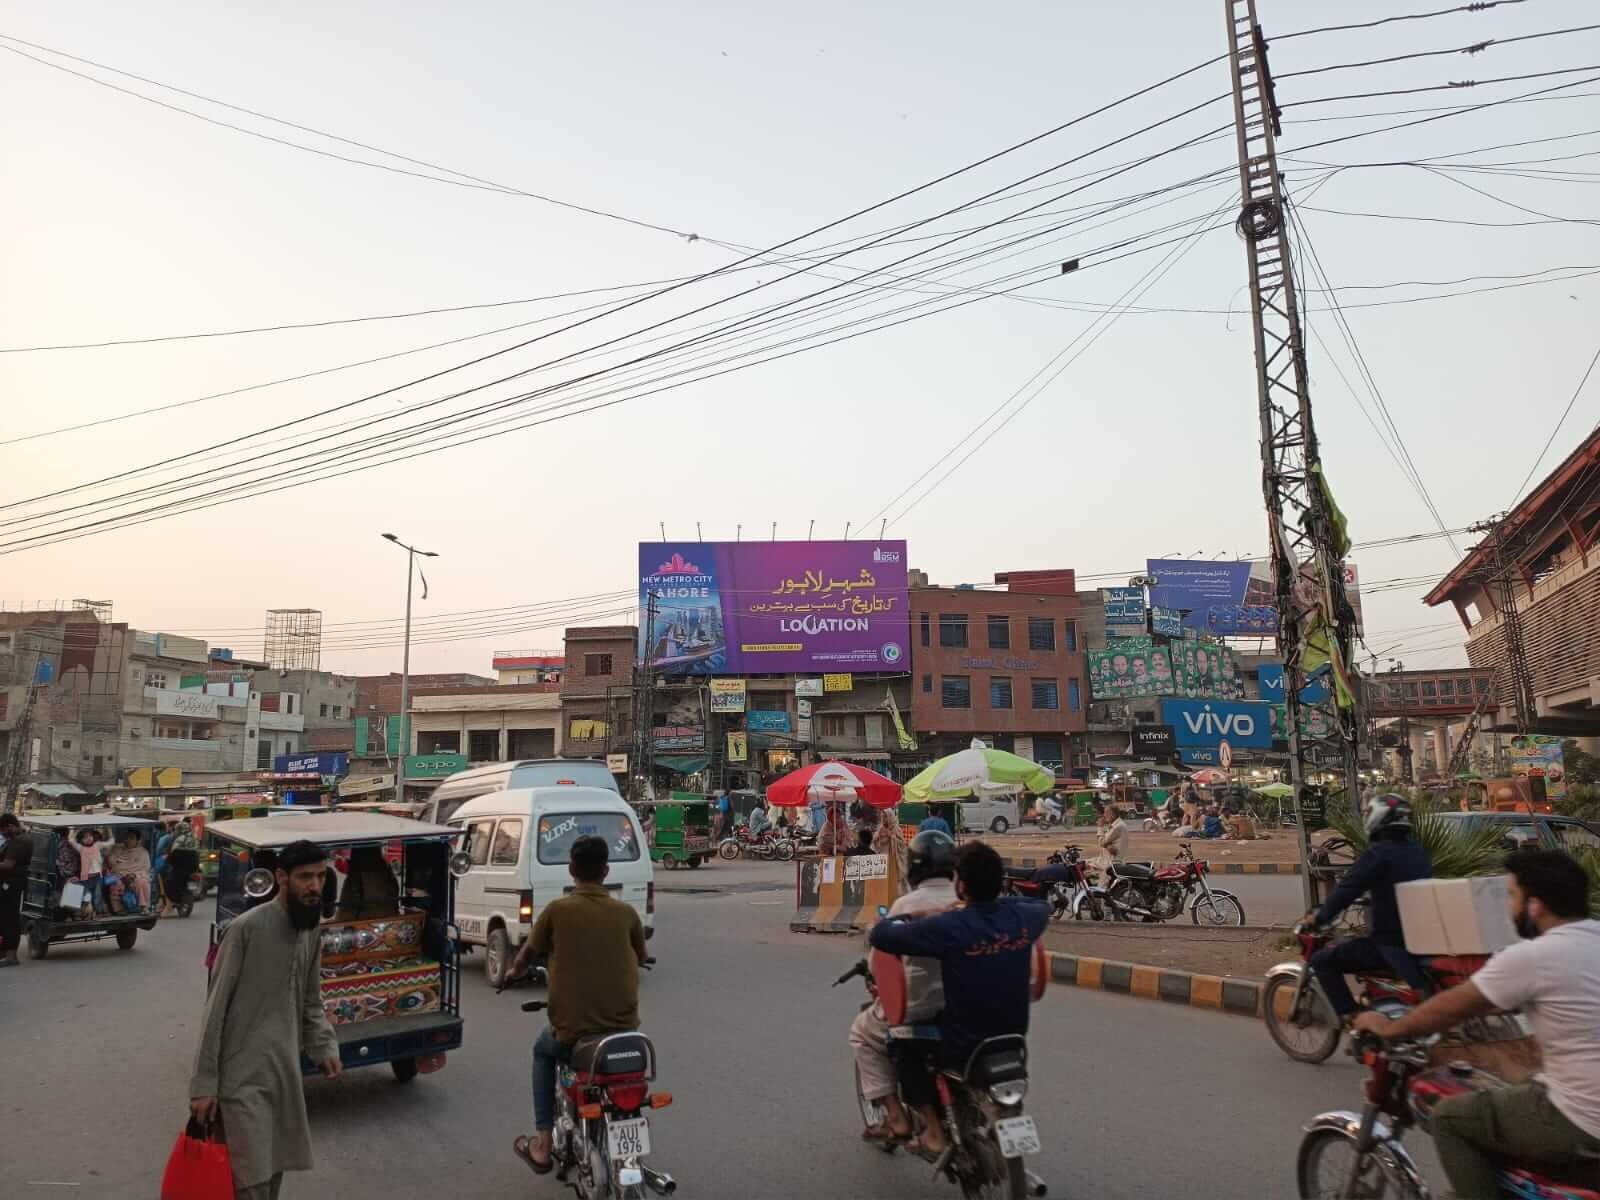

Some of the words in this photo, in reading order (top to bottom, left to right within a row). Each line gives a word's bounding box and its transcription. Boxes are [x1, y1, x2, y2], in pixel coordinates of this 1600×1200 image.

[642, 575, 660, 584] NEW
[662, 575, 692, 583] METRO
[693, 575, 713, 583] CITY
[780, 615, 869, 635] LOCATION
[1183, 703, 1255, 736] vivo
[1191, 751, 1213, 761] vivo
[617, 1140, 642, 1155] 1976
